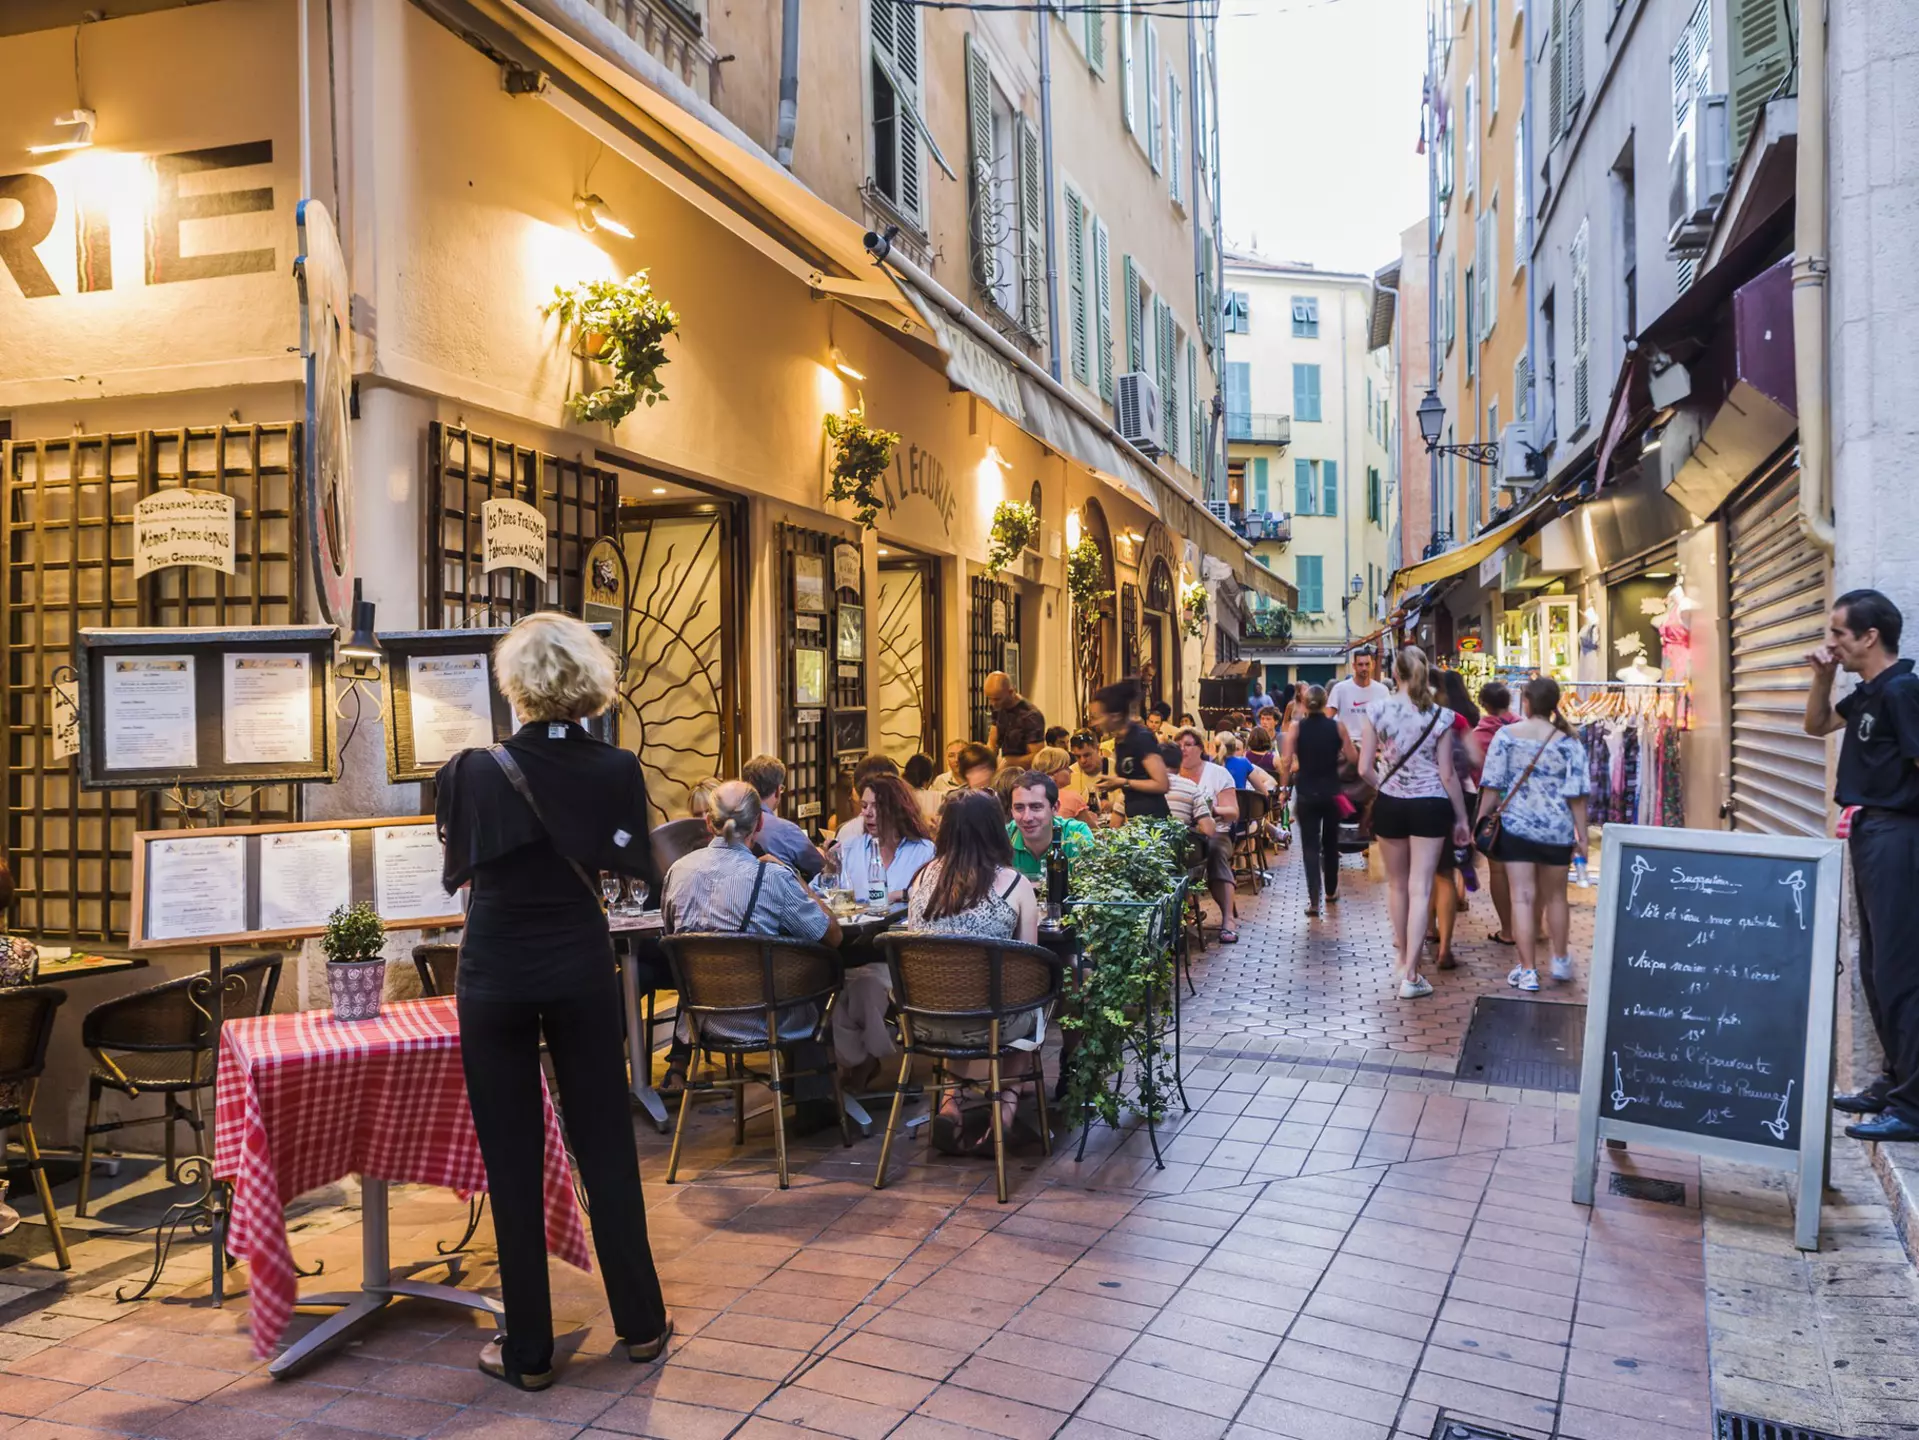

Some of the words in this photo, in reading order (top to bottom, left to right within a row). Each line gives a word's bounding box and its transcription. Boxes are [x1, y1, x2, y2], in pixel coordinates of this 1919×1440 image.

[170, 526, 202, 541] Patrons
[203, 524, 230, 550] depuis
[146, 553, 169, 568] Trois
[1717, 1080, 1733, 1095] de
